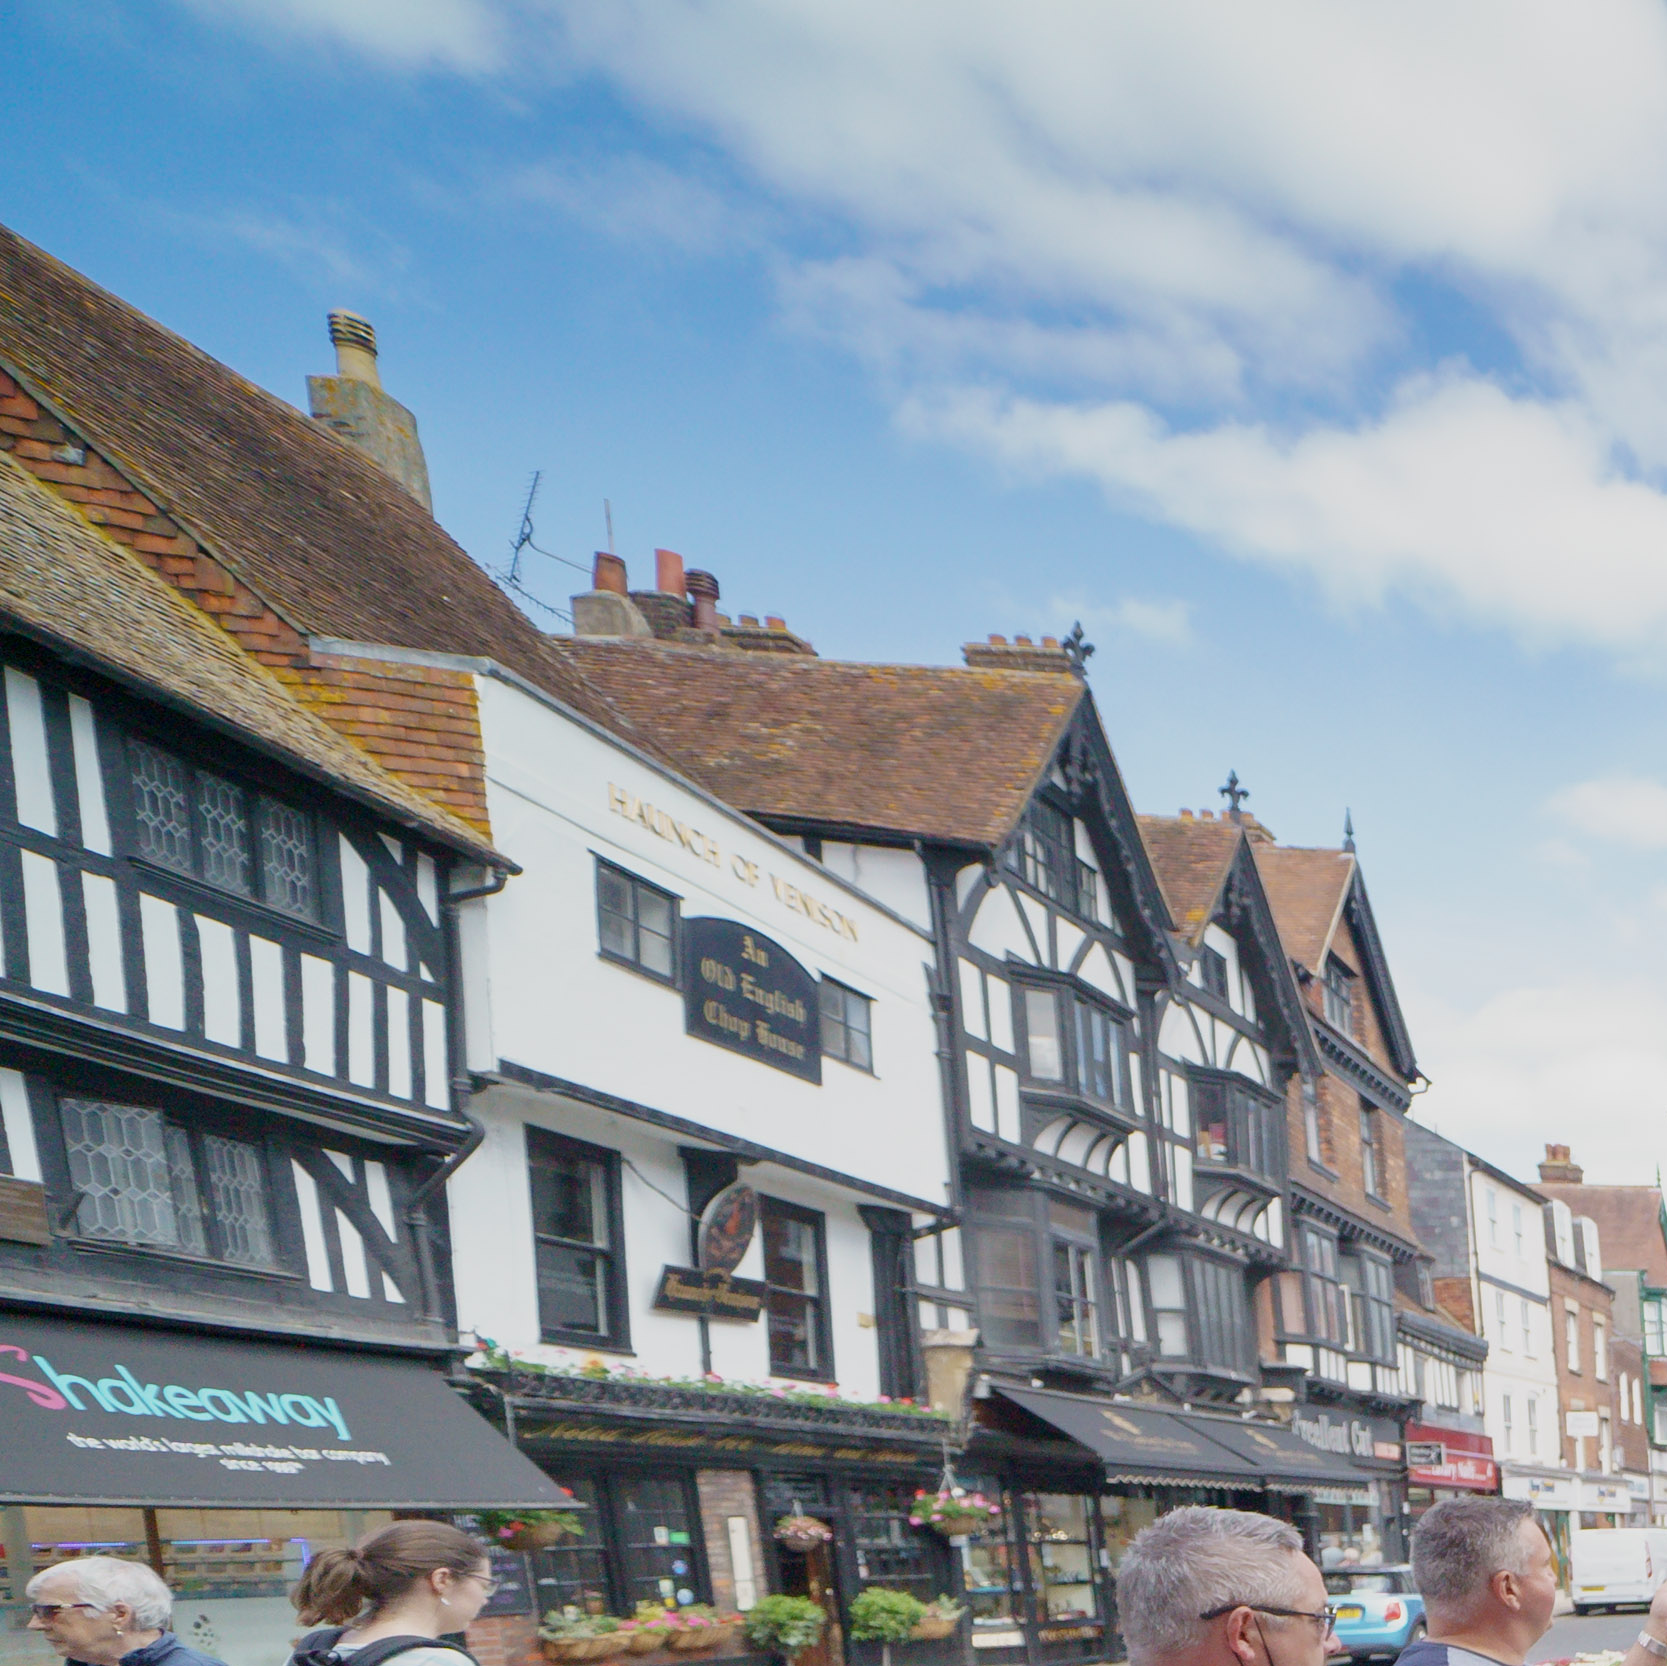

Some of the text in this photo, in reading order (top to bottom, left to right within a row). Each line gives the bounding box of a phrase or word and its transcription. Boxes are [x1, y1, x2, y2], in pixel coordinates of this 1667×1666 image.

[608, 782, 859, 942] HAUNCH OF VENISON
[741, 935, 769, 968] An
[701, 957, 807, 1022] Old English
[703, 999, 806, 1059] Chop House
